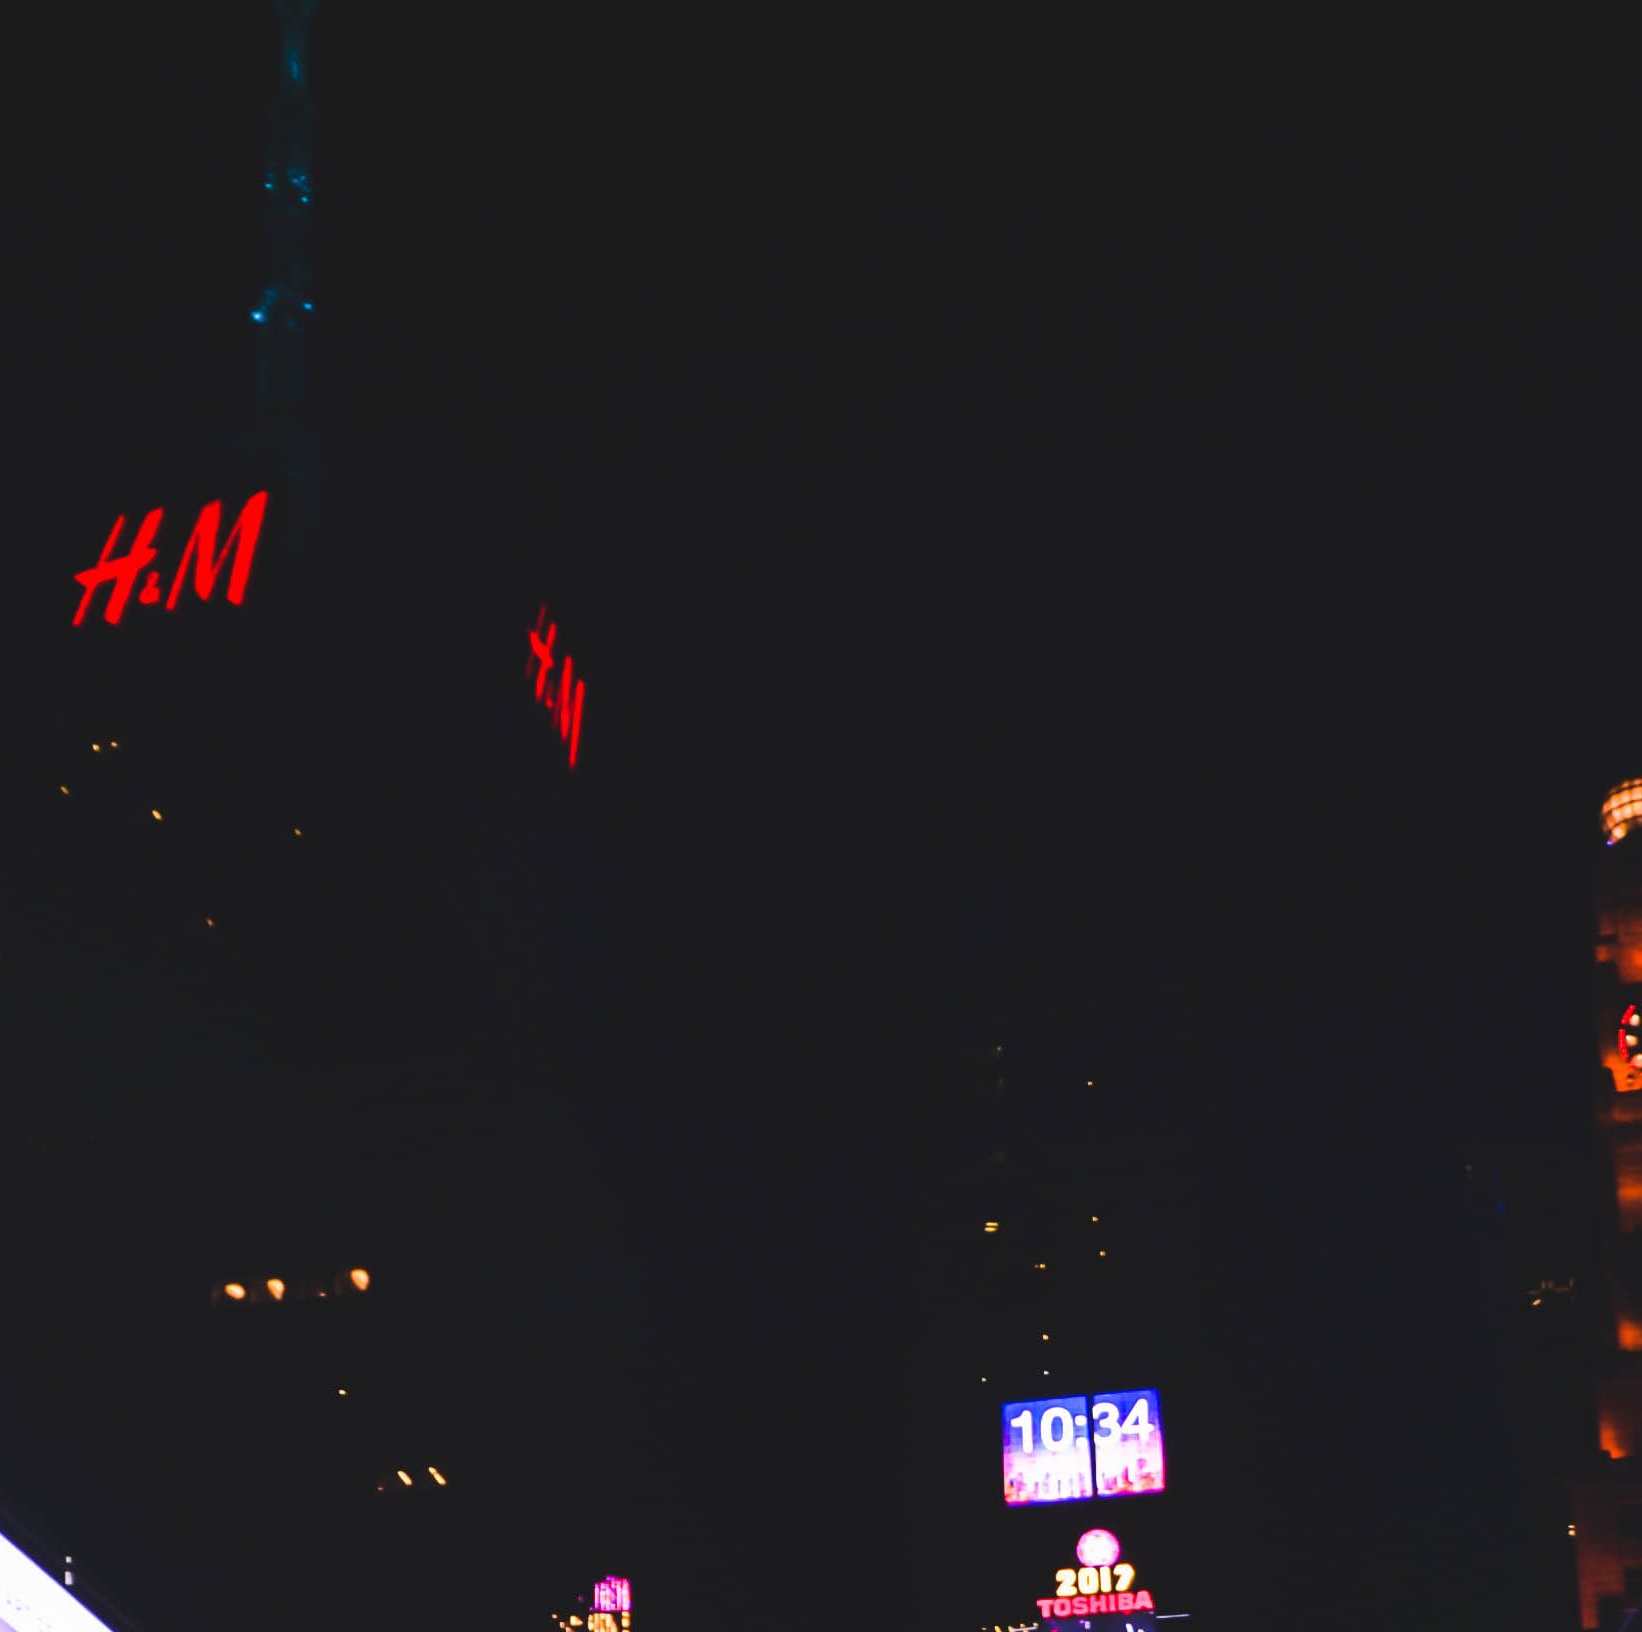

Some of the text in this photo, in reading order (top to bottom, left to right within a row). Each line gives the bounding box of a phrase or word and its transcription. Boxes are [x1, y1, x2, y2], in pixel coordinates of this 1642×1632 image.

[72, 489, 268, 627] H&M
[1010, 1397, 1155, 1455] 10:34
[1055, 1563, 1135, 1597] 2017
[1036, 1590, 1155, 1619] TOSHIBA
